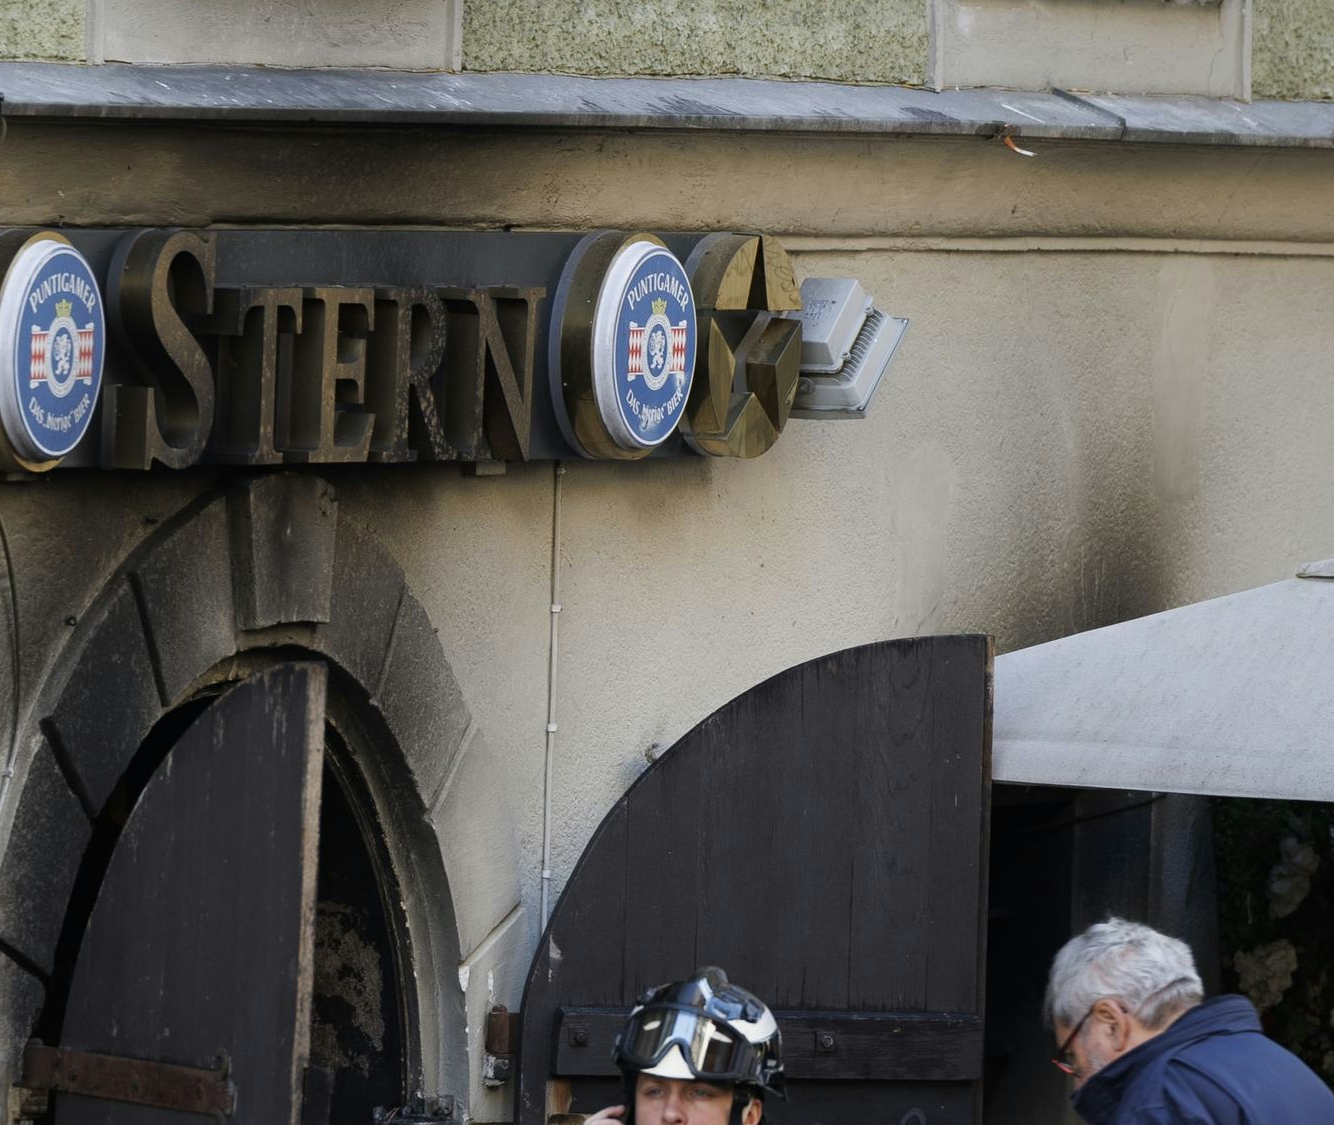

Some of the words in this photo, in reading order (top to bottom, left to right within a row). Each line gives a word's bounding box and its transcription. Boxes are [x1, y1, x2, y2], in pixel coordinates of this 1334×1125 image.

[29, 272, 96, 315] PUNTIGAMER
[627, 272, 690, 313] PUNTIGAMER
[147, 229, 546, 471] STERN
[29, 396, 44, 424] DAS
[73, 393, 91, 424] BIER
[626, 388, 640, 415] DAS
[667, 387, 683, 416] BIER
